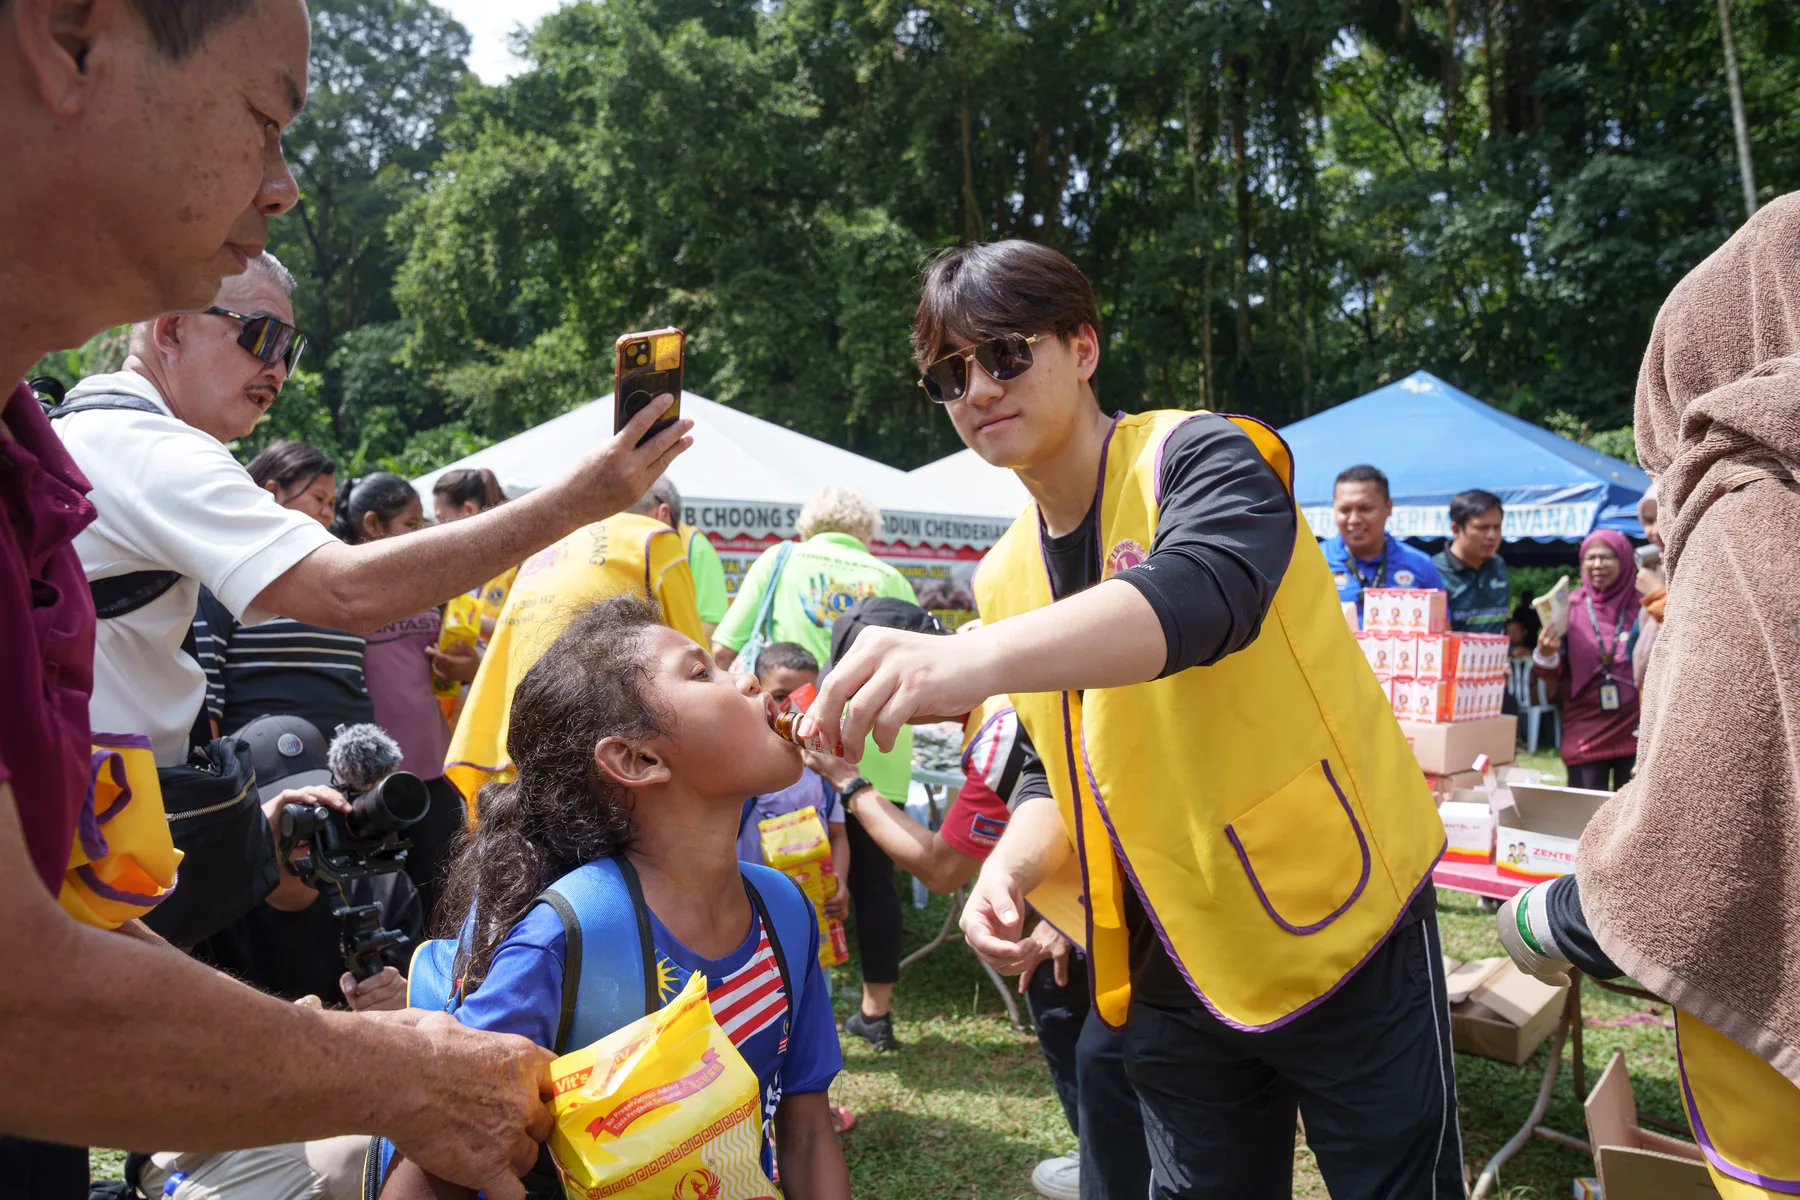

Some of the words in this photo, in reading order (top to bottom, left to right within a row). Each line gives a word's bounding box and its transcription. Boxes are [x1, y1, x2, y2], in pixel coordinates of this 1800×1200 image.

[685, 507, 696, 526] B
[702, 507, 781, 528] CHOONG
[555, 1073, 589, 1093] Vit's
[605, 1117, 615, 1127] No
[613, 1091, 656, 1118] Preservatives
[657, 1083, 679, 1094] Added
